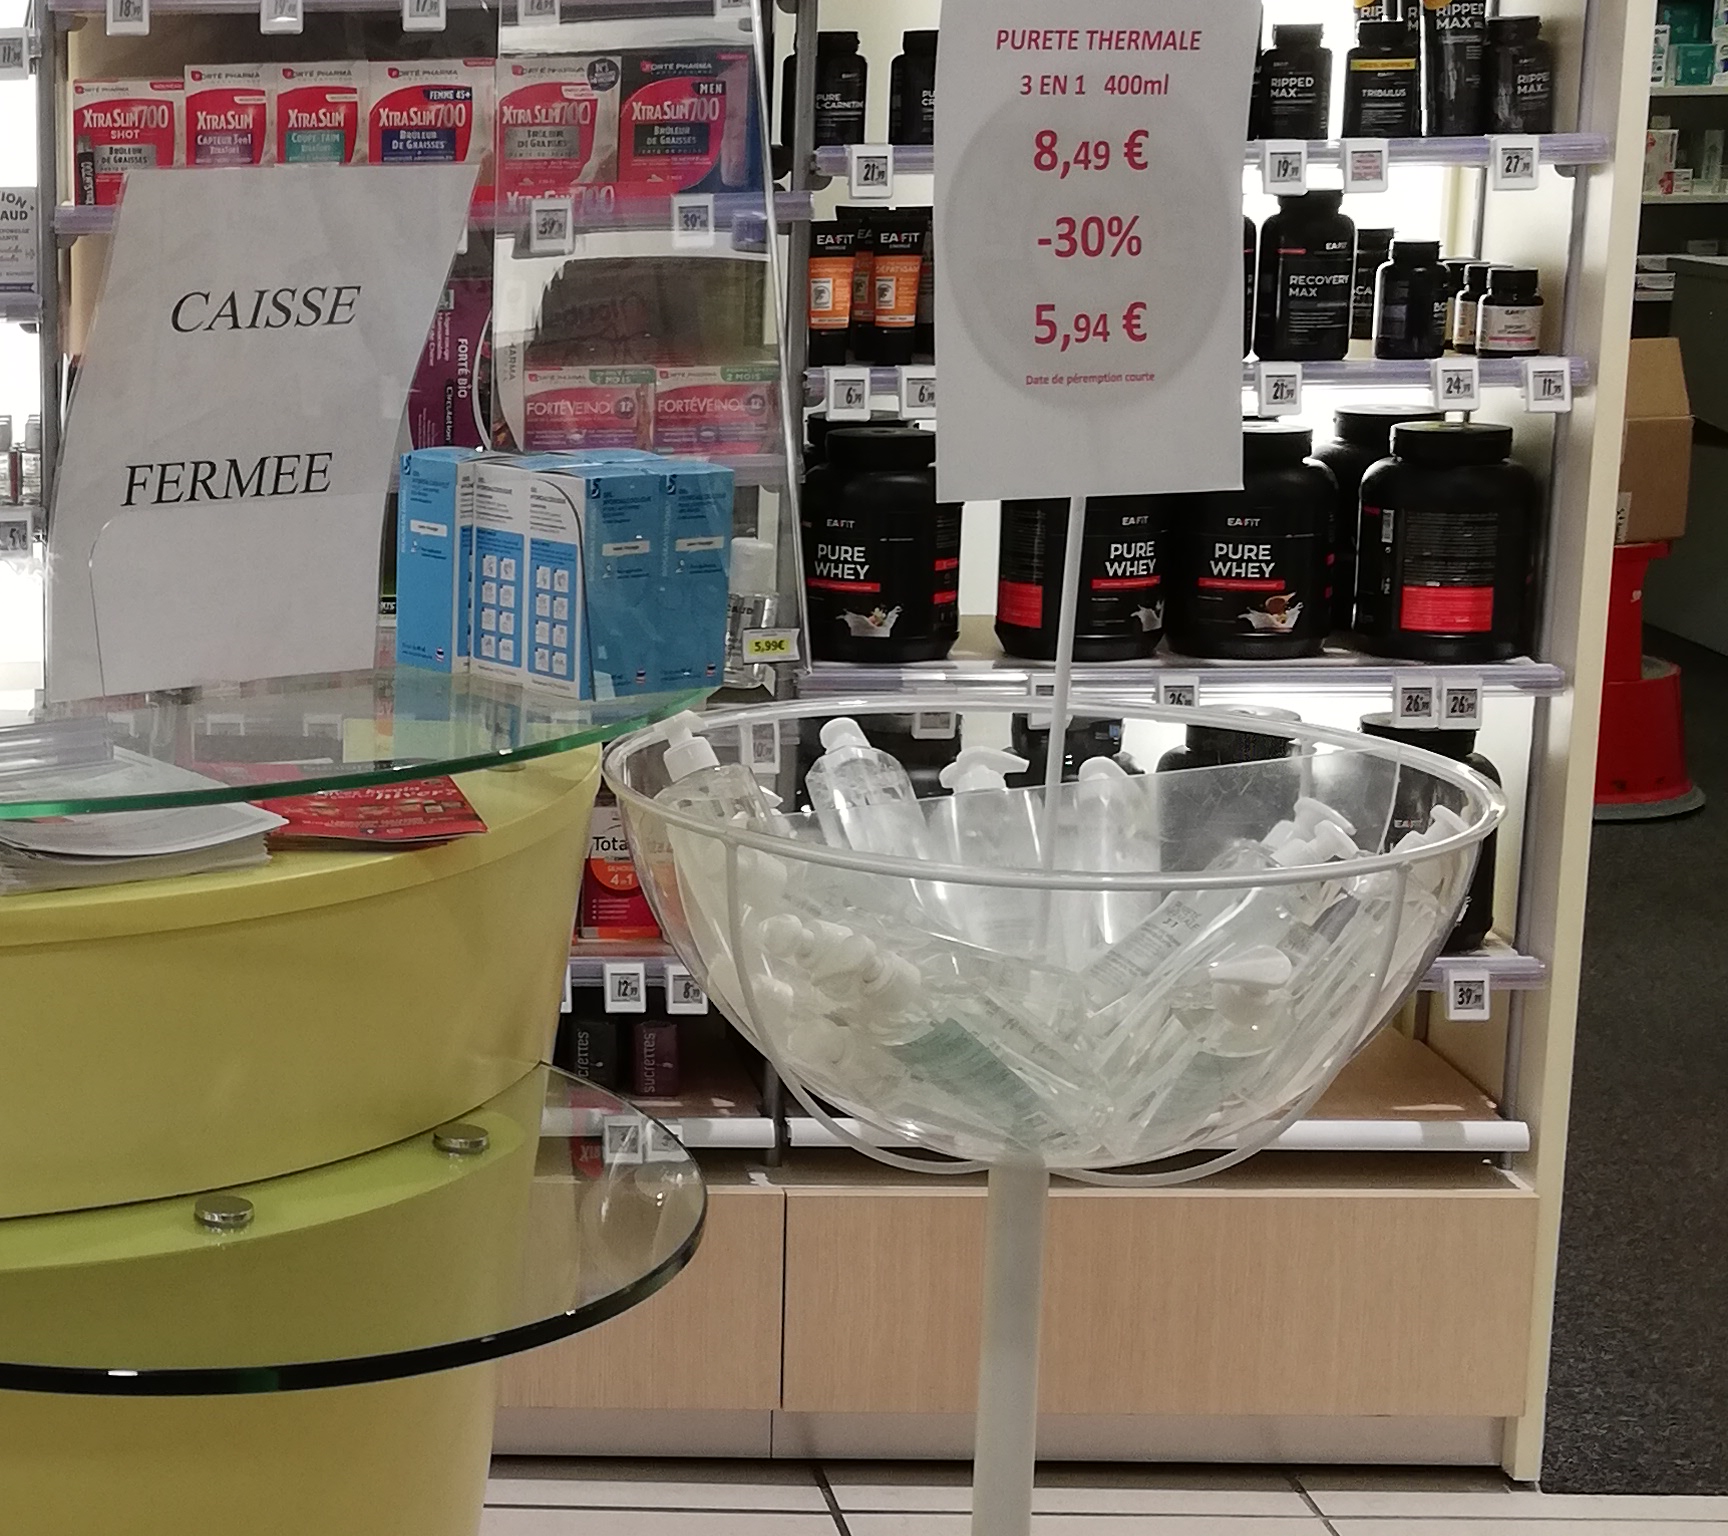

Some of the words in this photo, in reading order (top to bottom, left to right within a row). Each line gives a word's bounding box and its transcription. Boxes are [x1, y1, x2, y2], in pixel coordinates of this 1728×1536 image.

[996, 29, 1079, 51] PURETE
[1086, 29, 1202, 51] THERMALE
[1019, 74, 1032, 95] 3
[1040, 74, 1068, 95] EN
[1076, 74, 1086, 95] 1
[1104, 73, 1169, 95] 400ml
[1271, 77, 1314, 88] RIPPED
[1271, 87, 1297, 98] MAX
[1033, 130, 1111, 179] 8,49
[1123, 130, 1149, 170] €
[1037, 215, 1142, 257] -30%
[1289, 274, 1349, 285] RECOVERY
[1288, 287, 1318, 298] MAX
[172, 285, 361, 333] CAISSE
[1034, 303, 1111, 352] 5,94
[1122, 302, 1148, 342] €
[1025, 374, 1049, 385] Date
[1052, 372, 1063, 384] de
[1067, 372, 1122, 386] péremption
[1125, 372, 1155, 383] courte
[120, 452, 333, 507] FERMEE
[817, 543, 865, 563] PURE
[814, 560, 870, 580] WHEY
